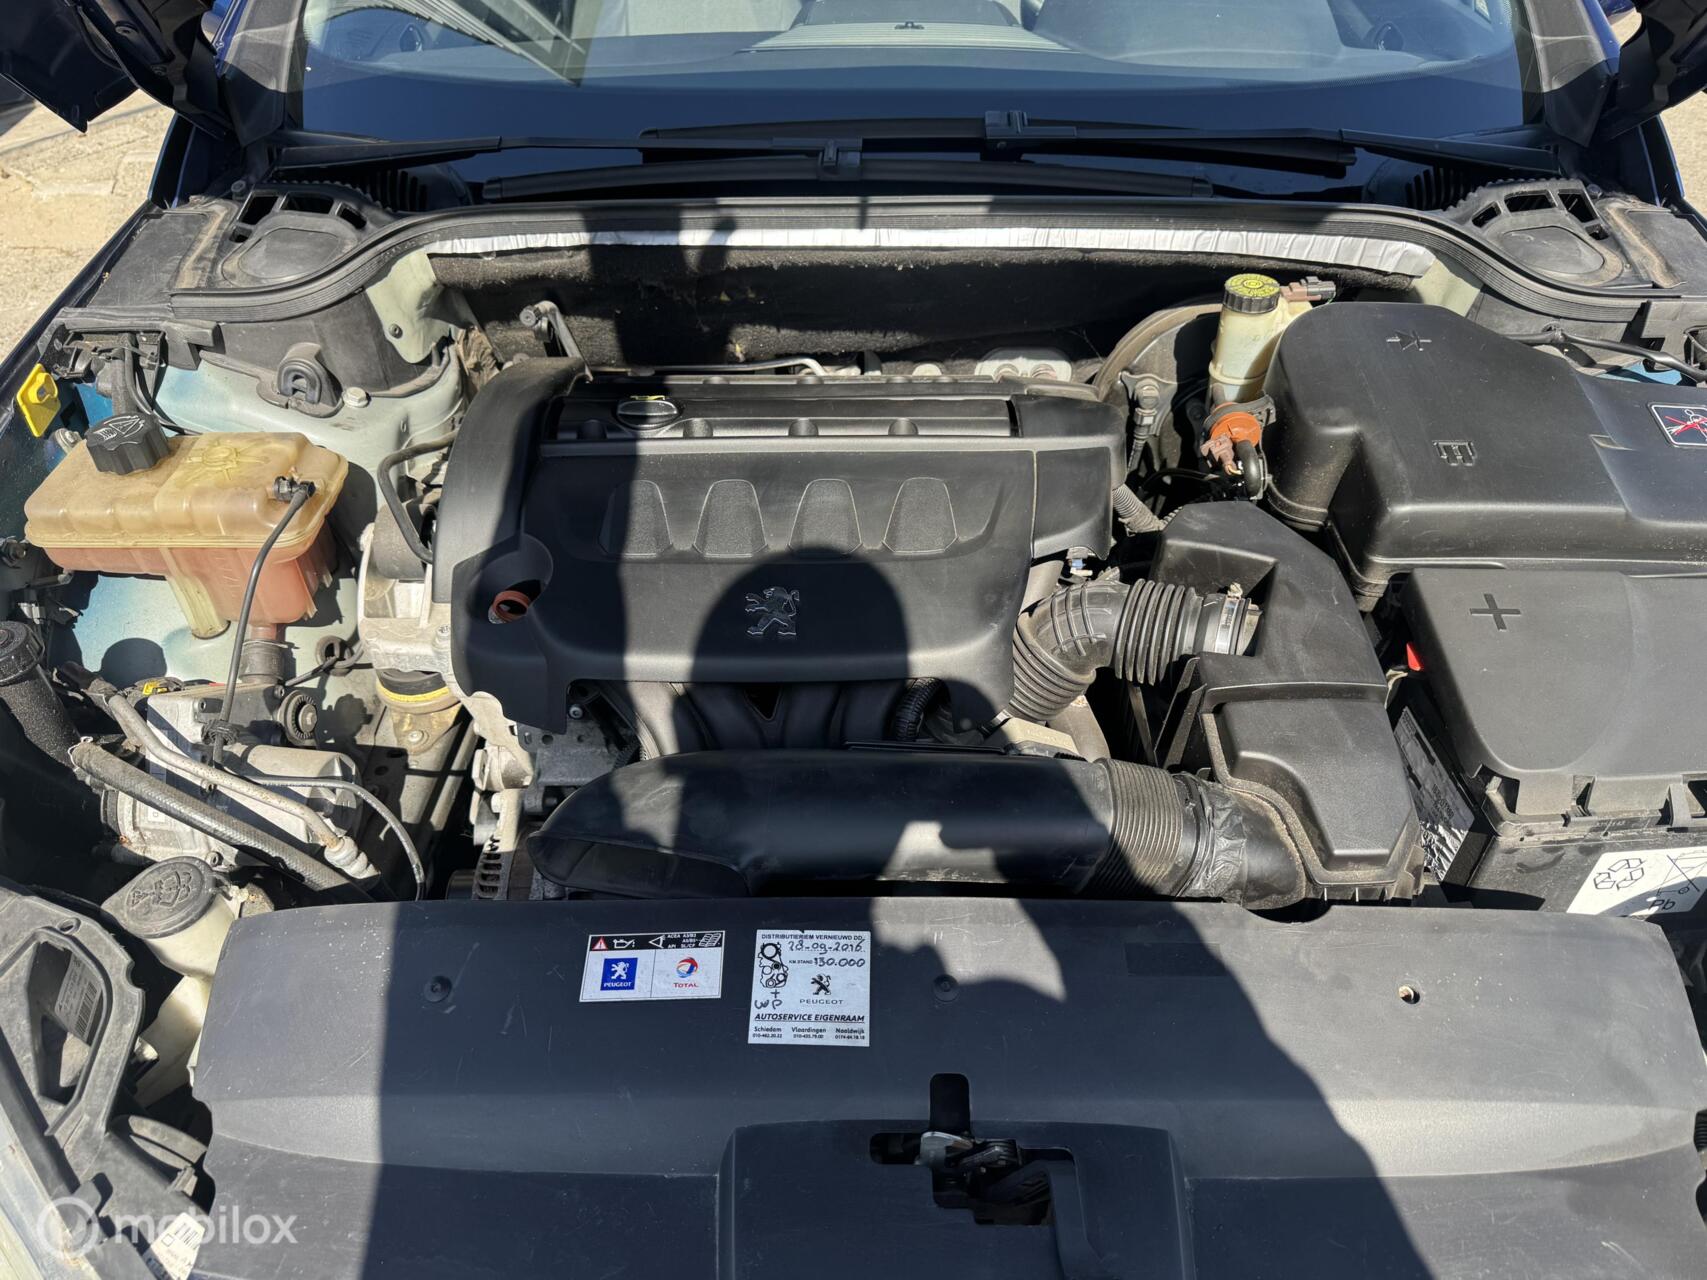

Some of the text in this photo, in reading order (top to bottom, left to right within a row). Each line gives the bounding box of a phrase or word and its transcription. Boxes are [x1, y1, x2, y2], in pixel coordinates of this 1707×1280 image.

[1649, 899, 1676, 911] Pb
[754, 1013, 865, 1022] AUTOSERVICE EIGENRAAM
